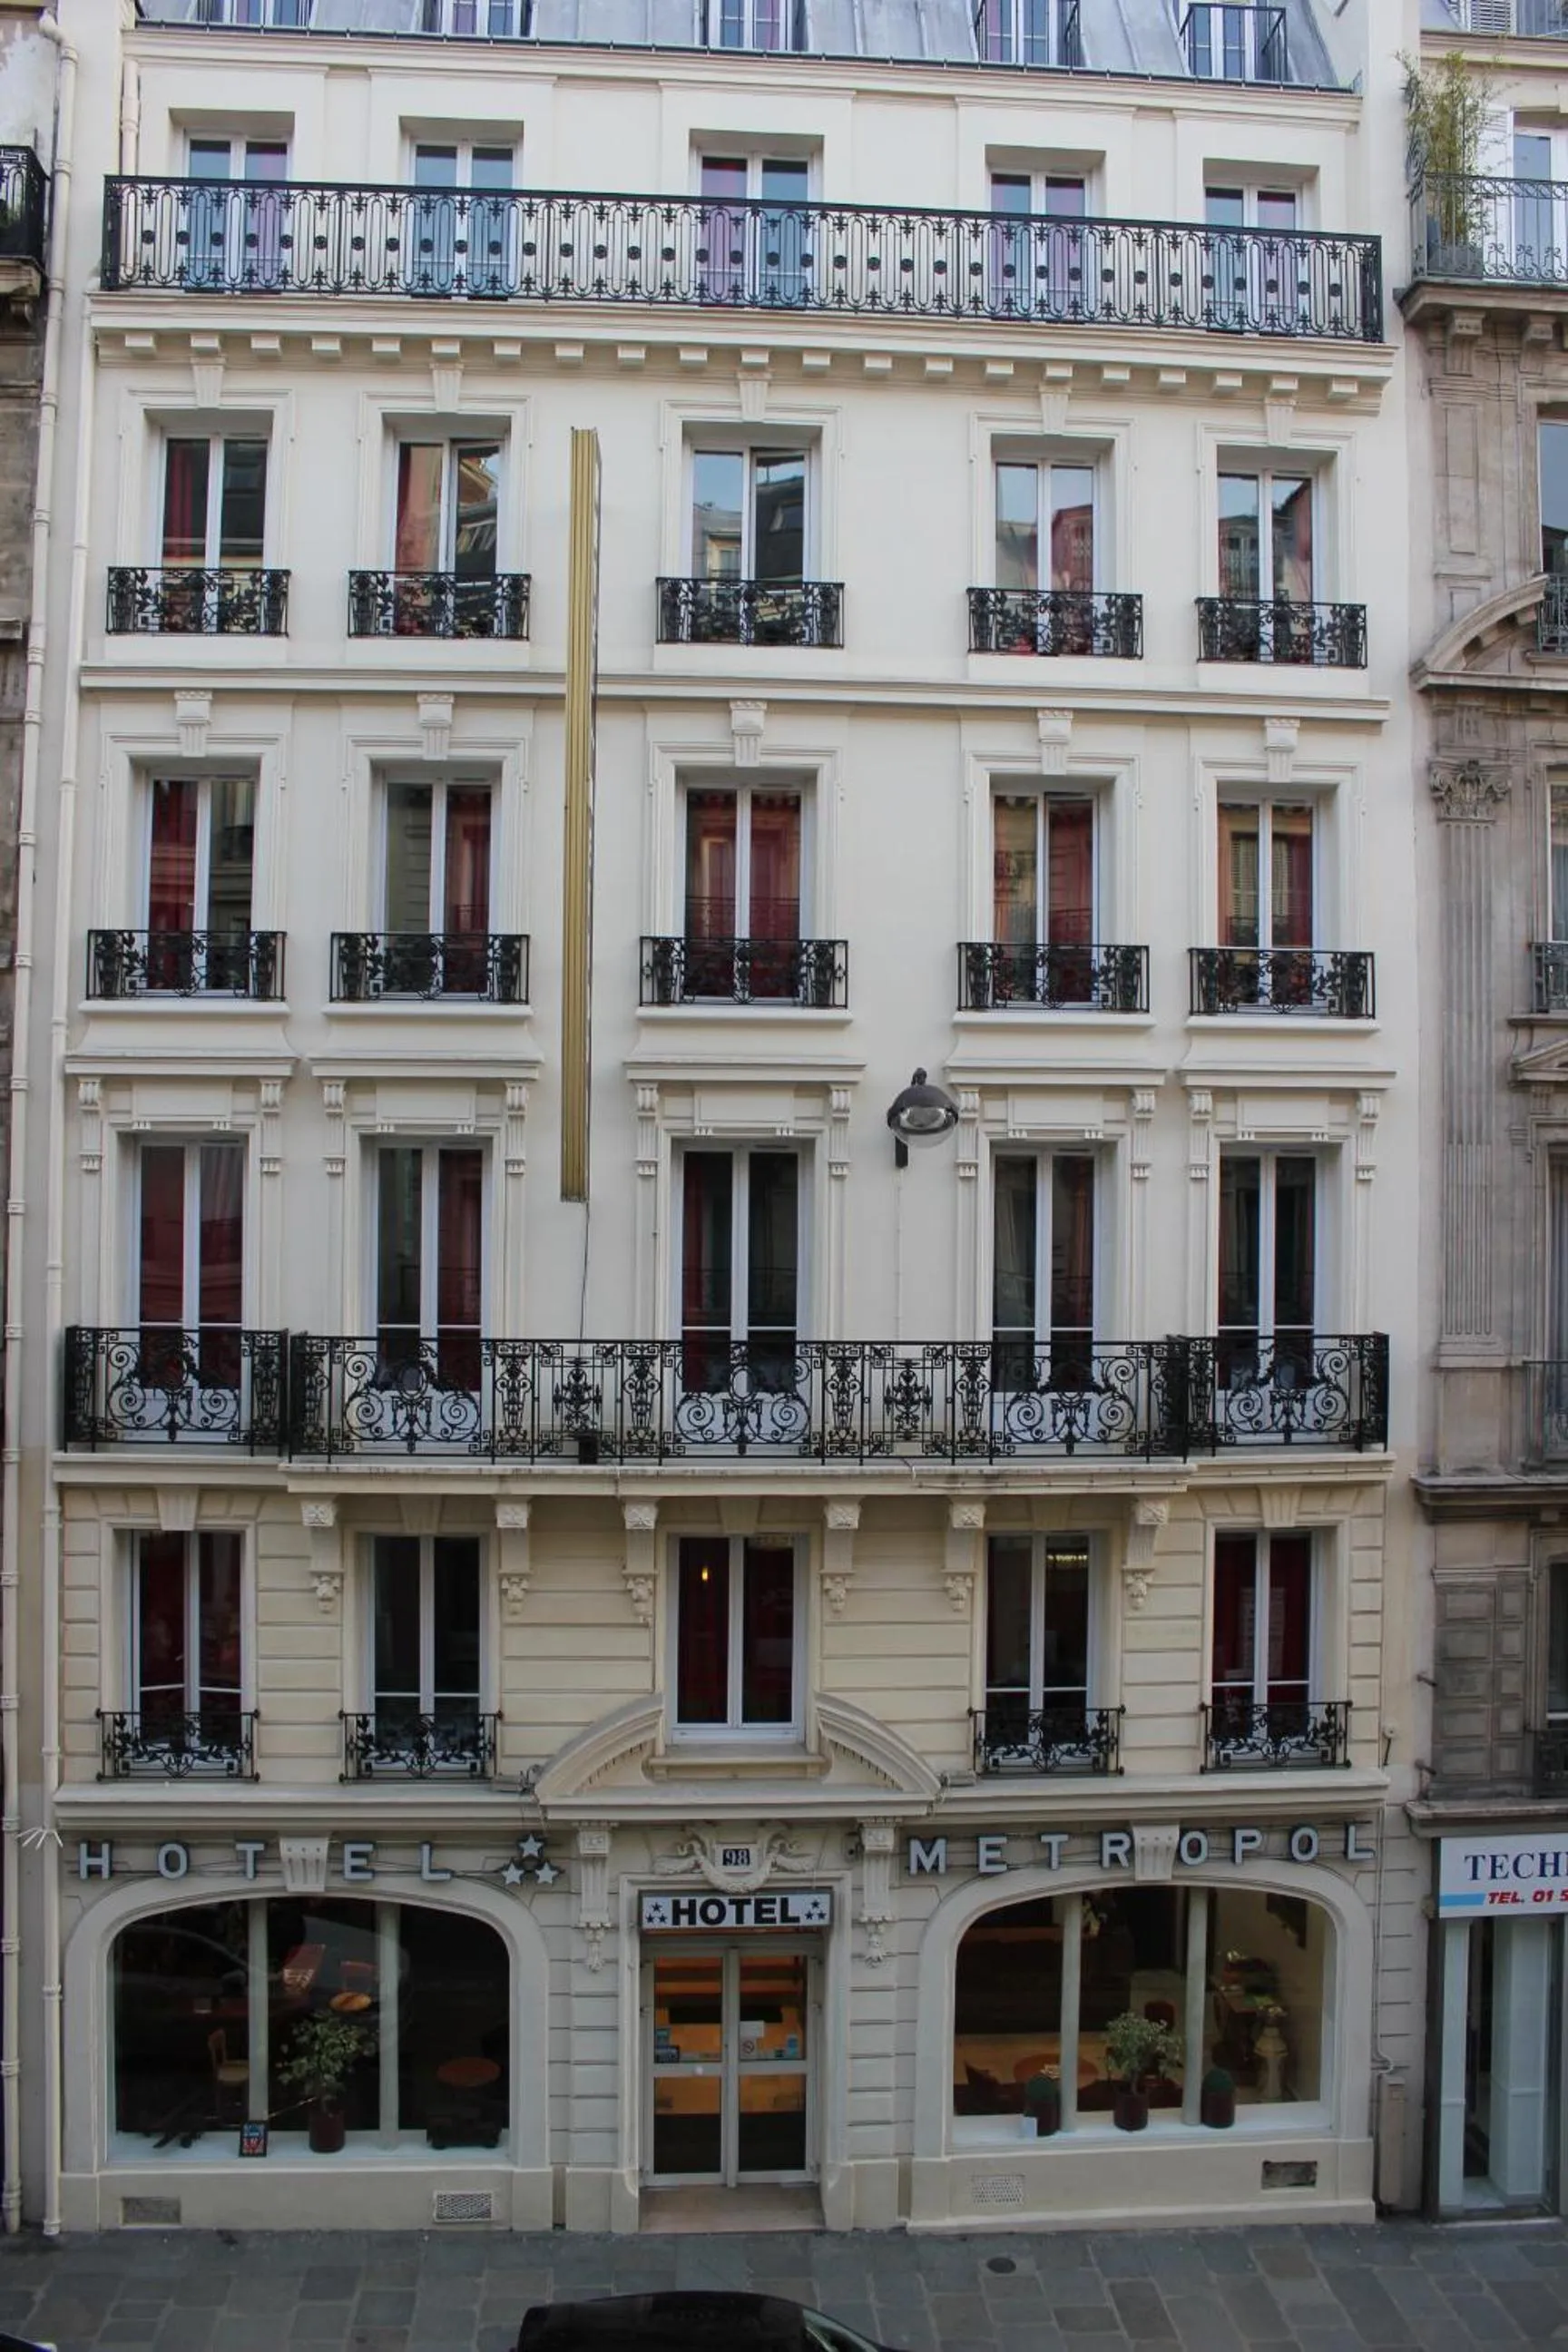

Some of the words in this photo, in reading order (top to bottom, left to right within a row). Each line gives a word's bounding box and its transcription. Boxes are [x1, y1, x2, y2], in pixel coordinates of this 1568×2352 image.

[78, 1842, 453, 1881] HOTEL
[725, 1849, 750, 1867] 98
[907, 1821, 1377, 1876] METROPOL
[671, 1896, 801, 1926] HOTEL
[1487, 1891, 1525, 1905] TEL.
[1532, 1889, 1554, 1903] 01
